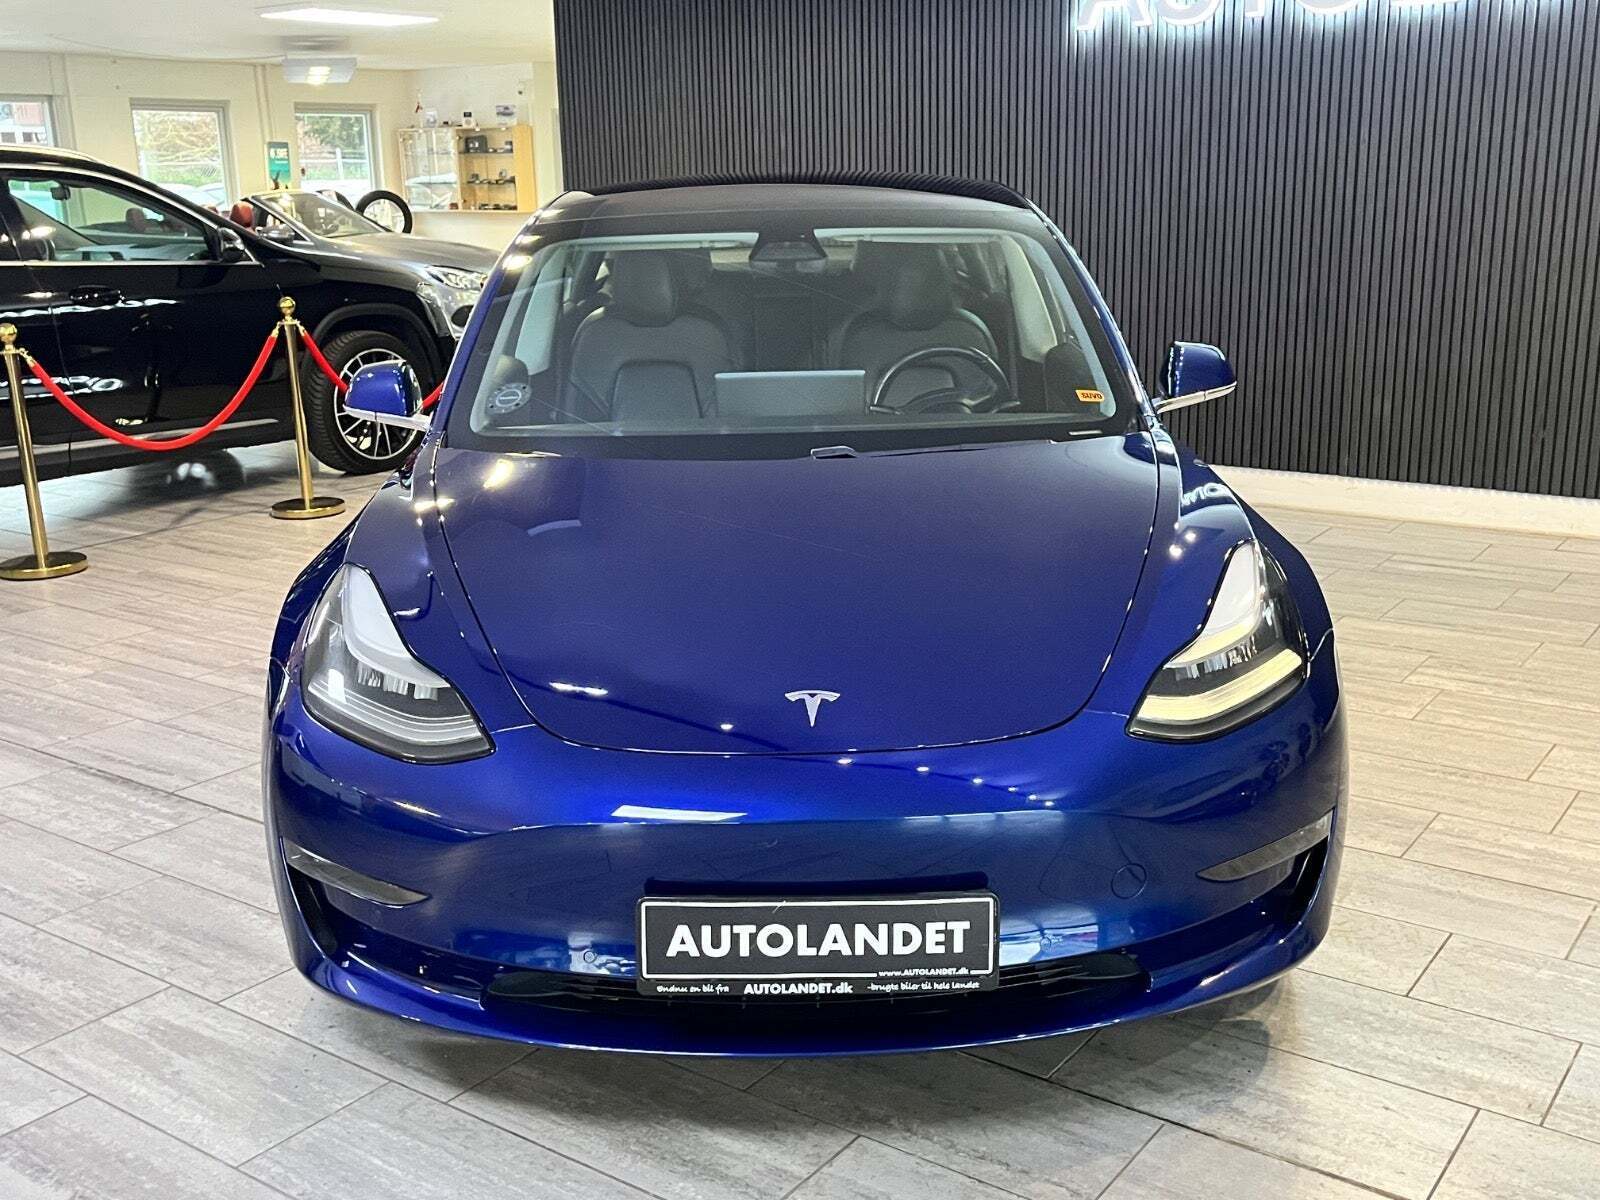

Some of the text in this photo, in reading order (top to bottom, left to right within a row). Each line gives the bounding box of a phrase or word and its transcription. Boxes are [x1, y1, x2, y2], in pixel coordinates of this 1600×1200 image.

[665, 920, 971, 957] AUTOLANDET
[878, 967, 970, 977] www.AUTOLANDET.dk
[702, 984, 715, 993] bil
[715, 983, 730, 995] fra
[743, 982, 854, 995] AUTOLANDET.dk
[900, 981, 920, 990] biler
[920, 981, 933, 990] til
